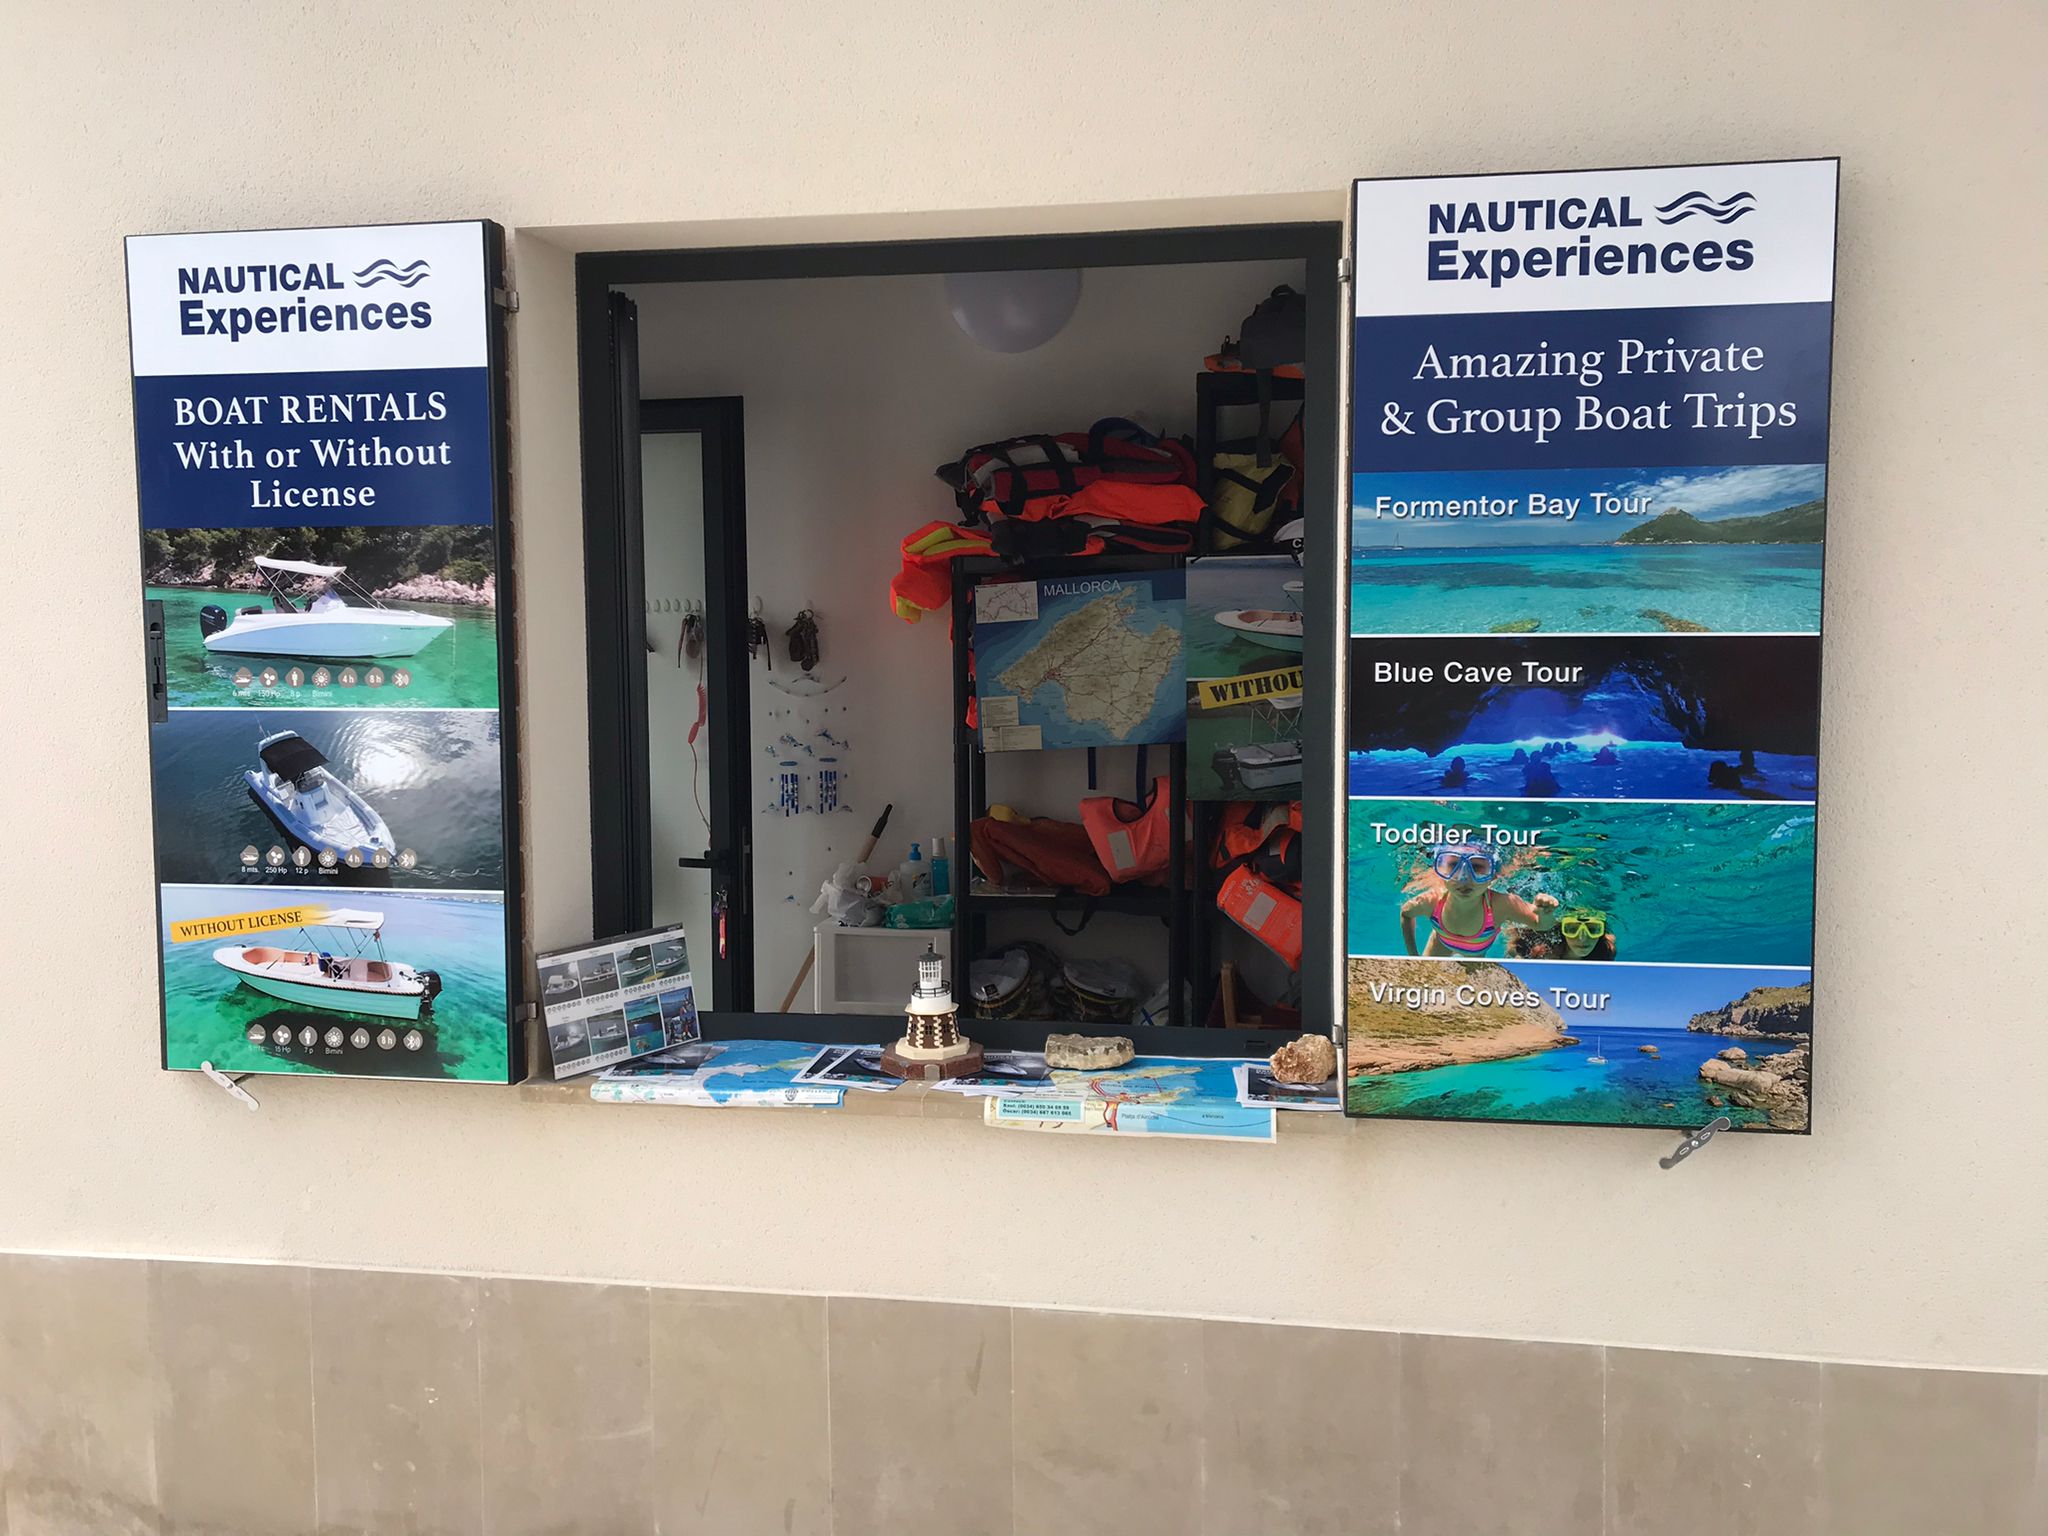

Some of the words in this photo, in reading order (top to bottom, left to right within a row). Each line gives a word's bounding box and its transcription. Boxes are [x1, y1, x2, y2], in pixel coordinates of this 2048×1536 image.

[1428, 196, 1643, 234] NAUTICAL
[1427, 235, 1755, 288] Experiences
[178, 262, 344, 294] NAUTICAL
[179, 296, 432, 342] Experiences
[1412, 341, 1605, 387] Amazing
[1617, 337, 1764, 374] Private
[173, 396, 268, 426] BOAT
[280, 391, 447, 424] RENTALS
[1381, 401, 1416, 435] &
[1427, 398, 1562, 443] Group
[1575, 396, 1672, 430] Boat
[1683, 391, 1797, 439] Trips
[173, 439, 255, 469] With
[265, 446, 301, 468] or
[310, 437, 451, 467] Without
[250, 479, 376, 508] License
[1375, 494, 1519, 518] Formentor
[1528, 493, 1580, 520] Bay
[1590, 492, 1652, 514] Tour
[1043, 579, 1121, 597] MALLORCA
[1209, 670, 1303, 702] WITHOU
[1374, 661, 1434, 683] Blue
[1443, 661, 1512, 683] Cave
[1521, 661, 1583, 683] Tour
[1370, 822, 1472, 845] Toddler
[1480, 824, 1541, 846] Tour
[265, 866, 277, 874] 250
[277, 867, 288, 875] Hp
[318, 867, 339, 875] Bimini
[179, 919, 246, 937] WITHOUT
[248, 911, 303, 929] LICENSE
[1369, 981, 1446, 1009] Virgin
[1455, 984, 1541, 1008] Coves
[1550, 987, 1612, 1009] Tour
[282, 1046, 292, 1054] Hp
